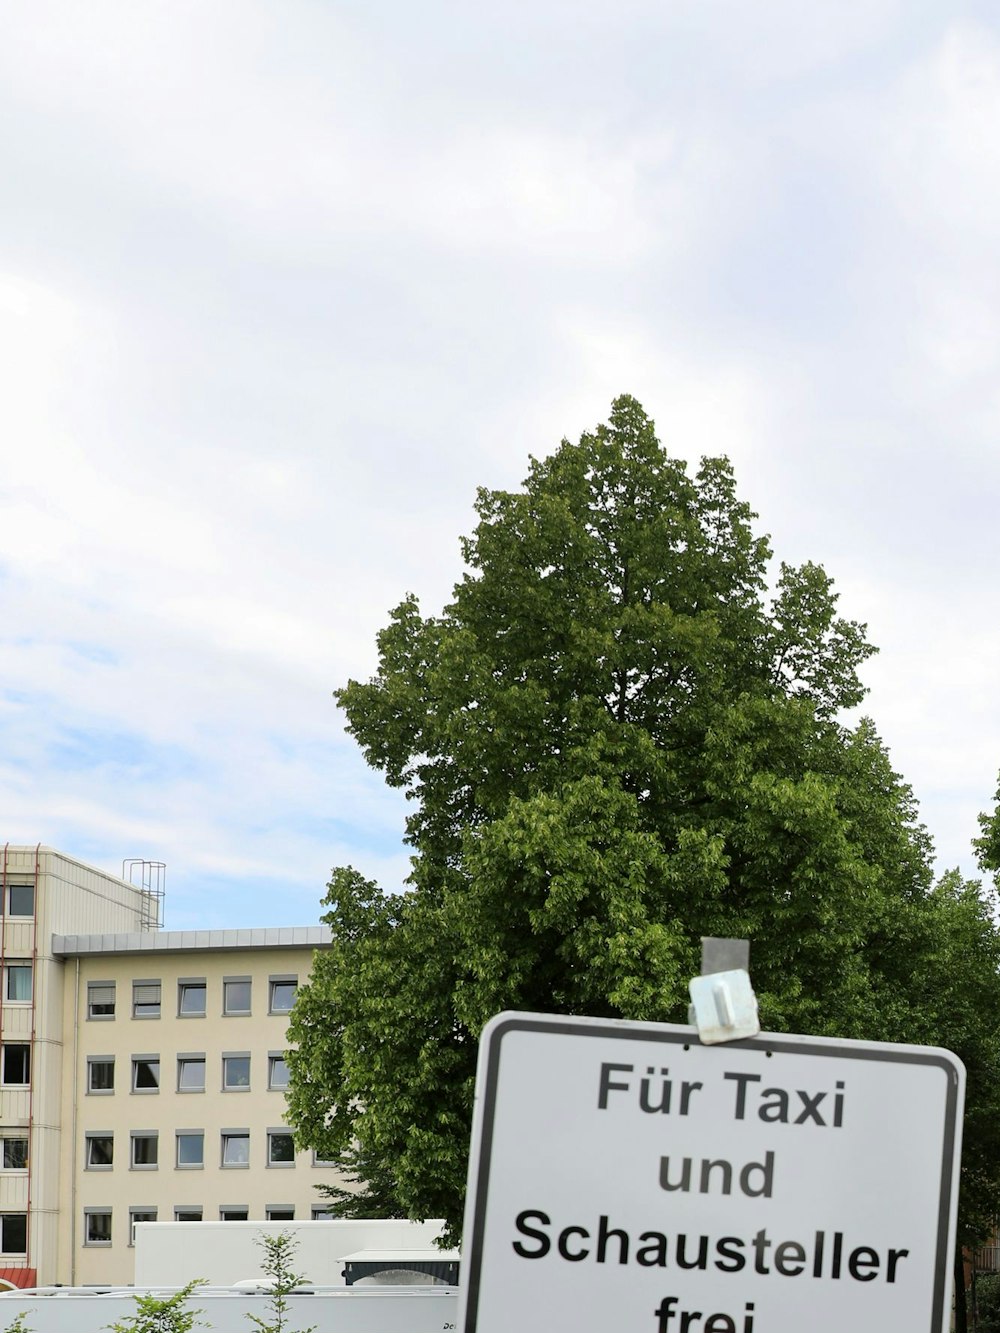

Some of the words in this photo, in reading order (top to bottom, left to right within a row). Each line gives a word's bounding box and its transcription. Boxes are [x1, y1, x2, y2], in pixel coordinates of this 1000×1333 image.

[597, 1061, 704, 1116] Für
[723, 1072, 846, 1128] Taxi
[658, 1151, 775, 1198] und
[511, 1208, 910, 1284] Schausteller
